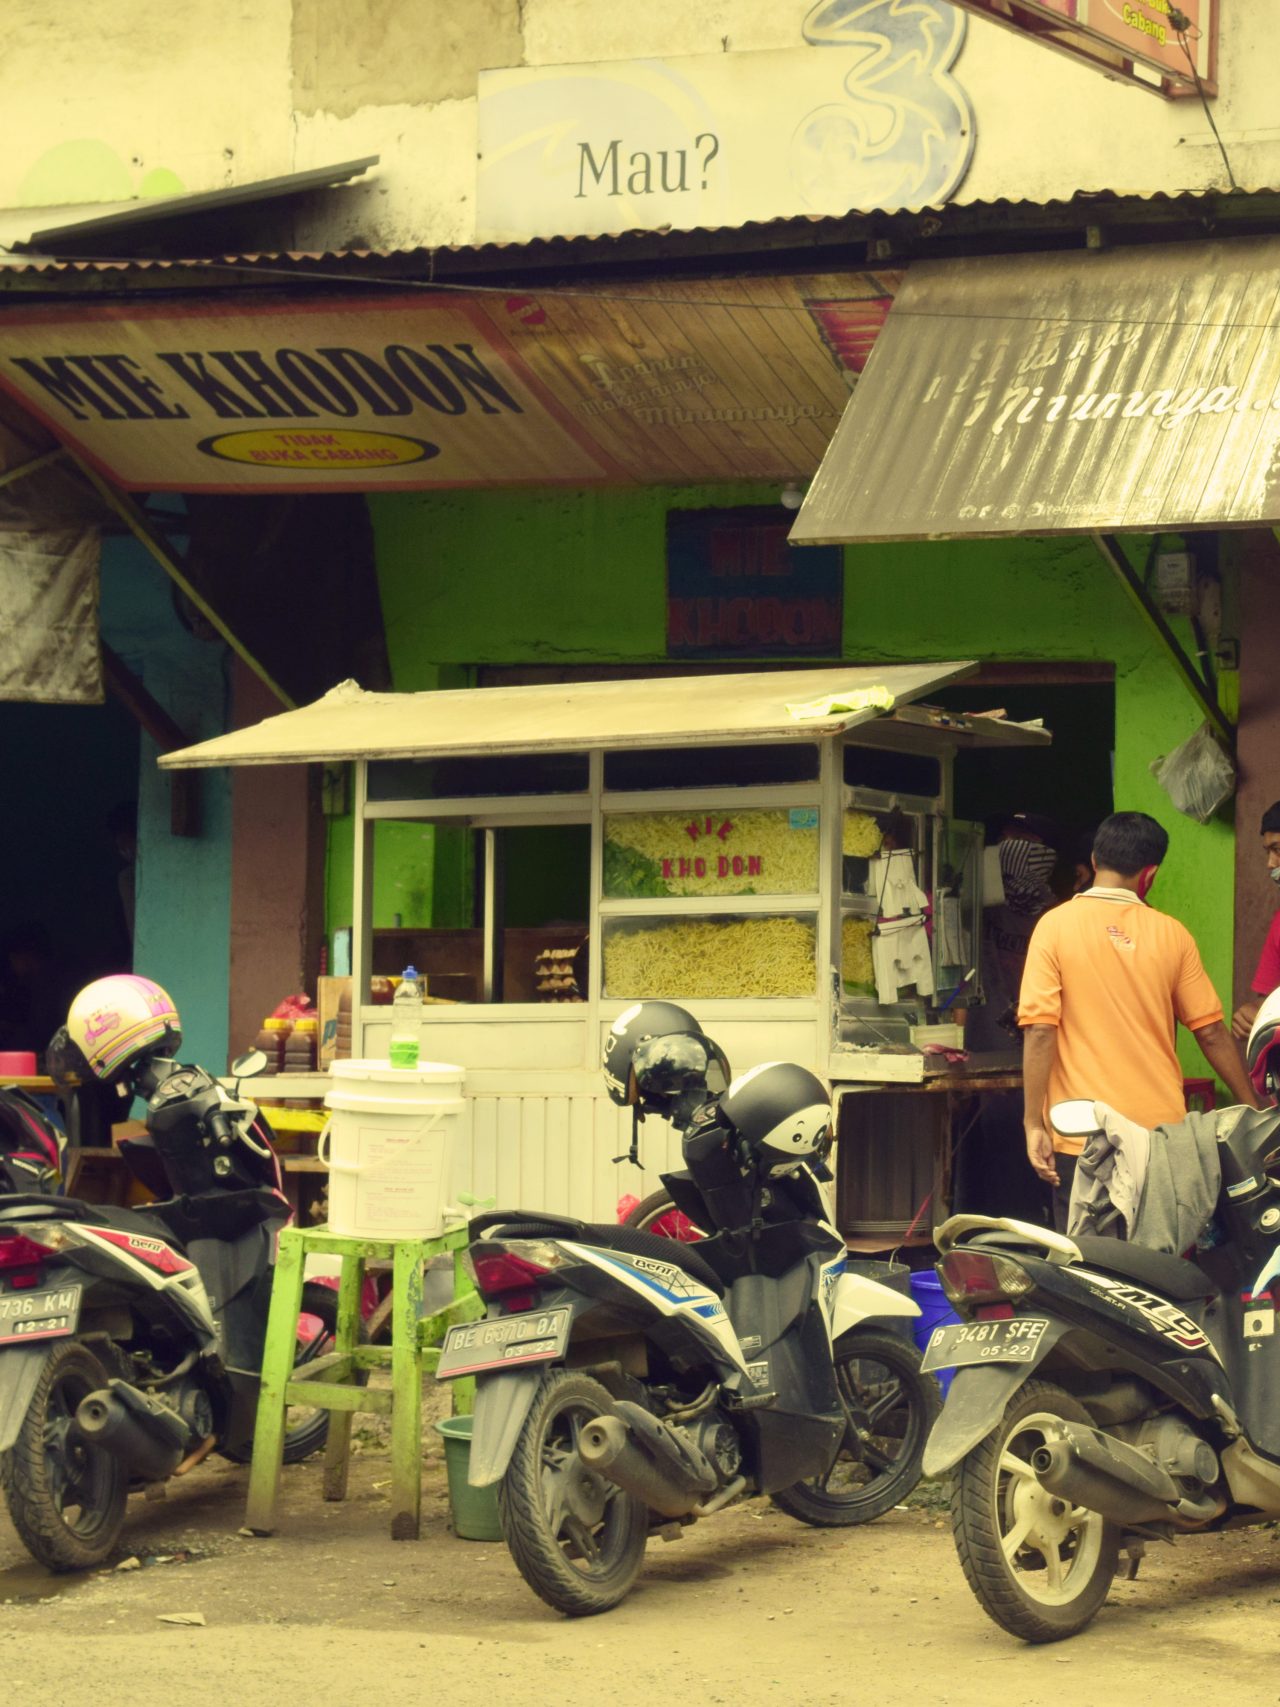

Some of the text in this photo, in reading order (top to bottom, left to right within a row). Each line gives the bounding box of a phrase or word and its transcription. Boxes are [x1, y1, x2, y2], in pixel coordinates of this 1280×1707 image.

[1121, 3, 1167, 47] Cabang
[575, 132, 720, 200] Mau?
[9, 343, 525, 421] MIE KHODON
[250, 447, 400, 463] BUKA CABANG
[273, 434, 340, 448] TIDAK
[710, 526, 794, 577] MIE
[669, 597, 840, 646] KHODON
[1, 1292, 73, 1320] 736 KM
[453, 1330, 476, 1351] BE
[483, 1321, 528, 1345] 6370
[931, 1322, 1044, 1347] B 3481 SFE
